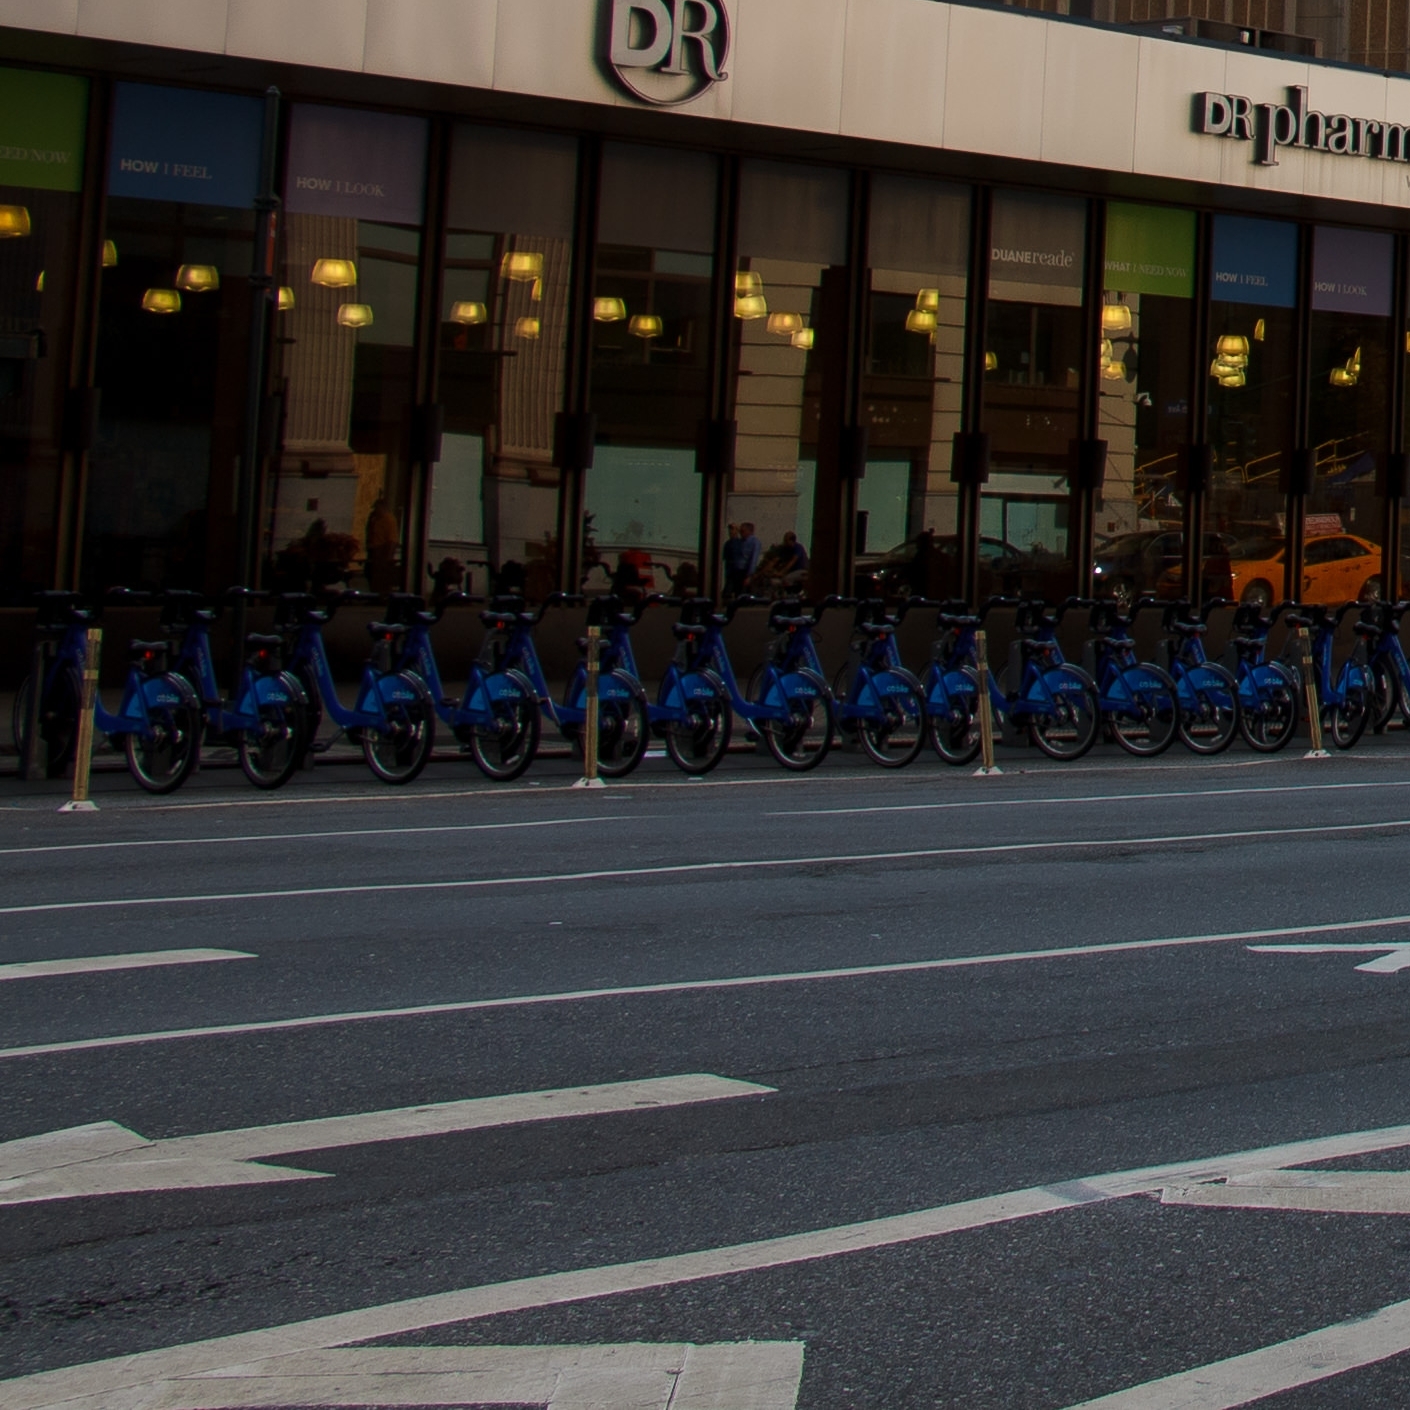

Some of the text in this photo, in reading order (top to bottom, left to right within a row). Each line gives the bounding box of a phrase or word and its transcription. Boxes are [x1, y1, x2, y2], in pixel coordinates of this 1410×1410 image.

[1201, 90, 1257, 141] DR
[120, 157, 159, 174] HOW
[172, 163, 213, 180] FEEL
[295, 176, 332, 192] HOW
[343, 181, 385, 197] LOOK
[1215, 270, 1237, 283] HOW
[1245, 274, 1268, 286] FEEL
[1314, 281, 1335, 293] HOW
[1342, 284, 1367, 296] LOOK
